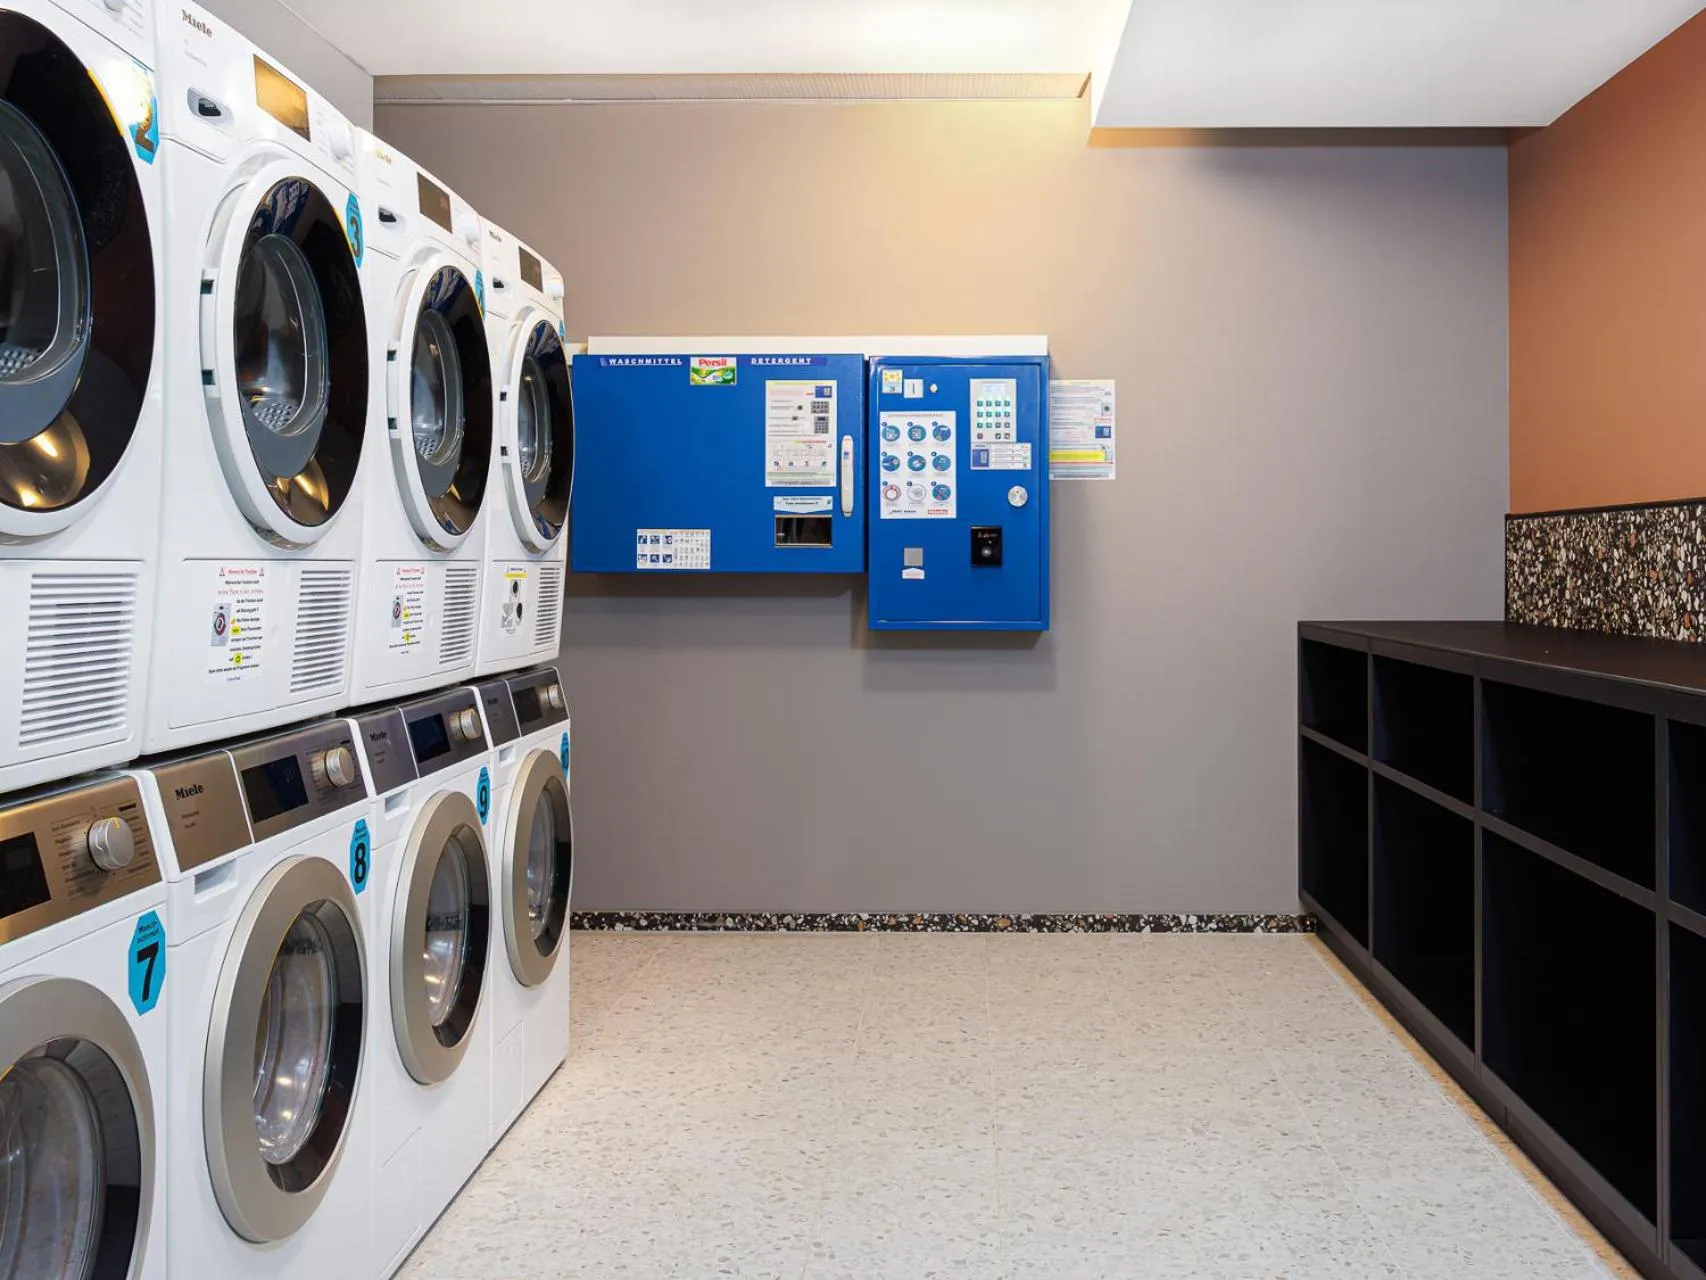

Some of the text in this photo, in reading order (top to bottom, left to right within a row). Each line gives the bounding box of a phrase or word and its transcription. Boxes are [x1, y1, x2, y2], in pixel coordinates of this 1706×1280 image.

[181, 9, 212, 37] Miele
[350, 216, 360, 257] 3
[699, 358, 727, 366] Persil
[751, 357, 812, 365] DETERGENT
[175, 784, 204, 800] Miele
[480, 786, 488, 817] 9
[354, 842, 367, 884] 8
[136, 941, 160, 1003] 7
